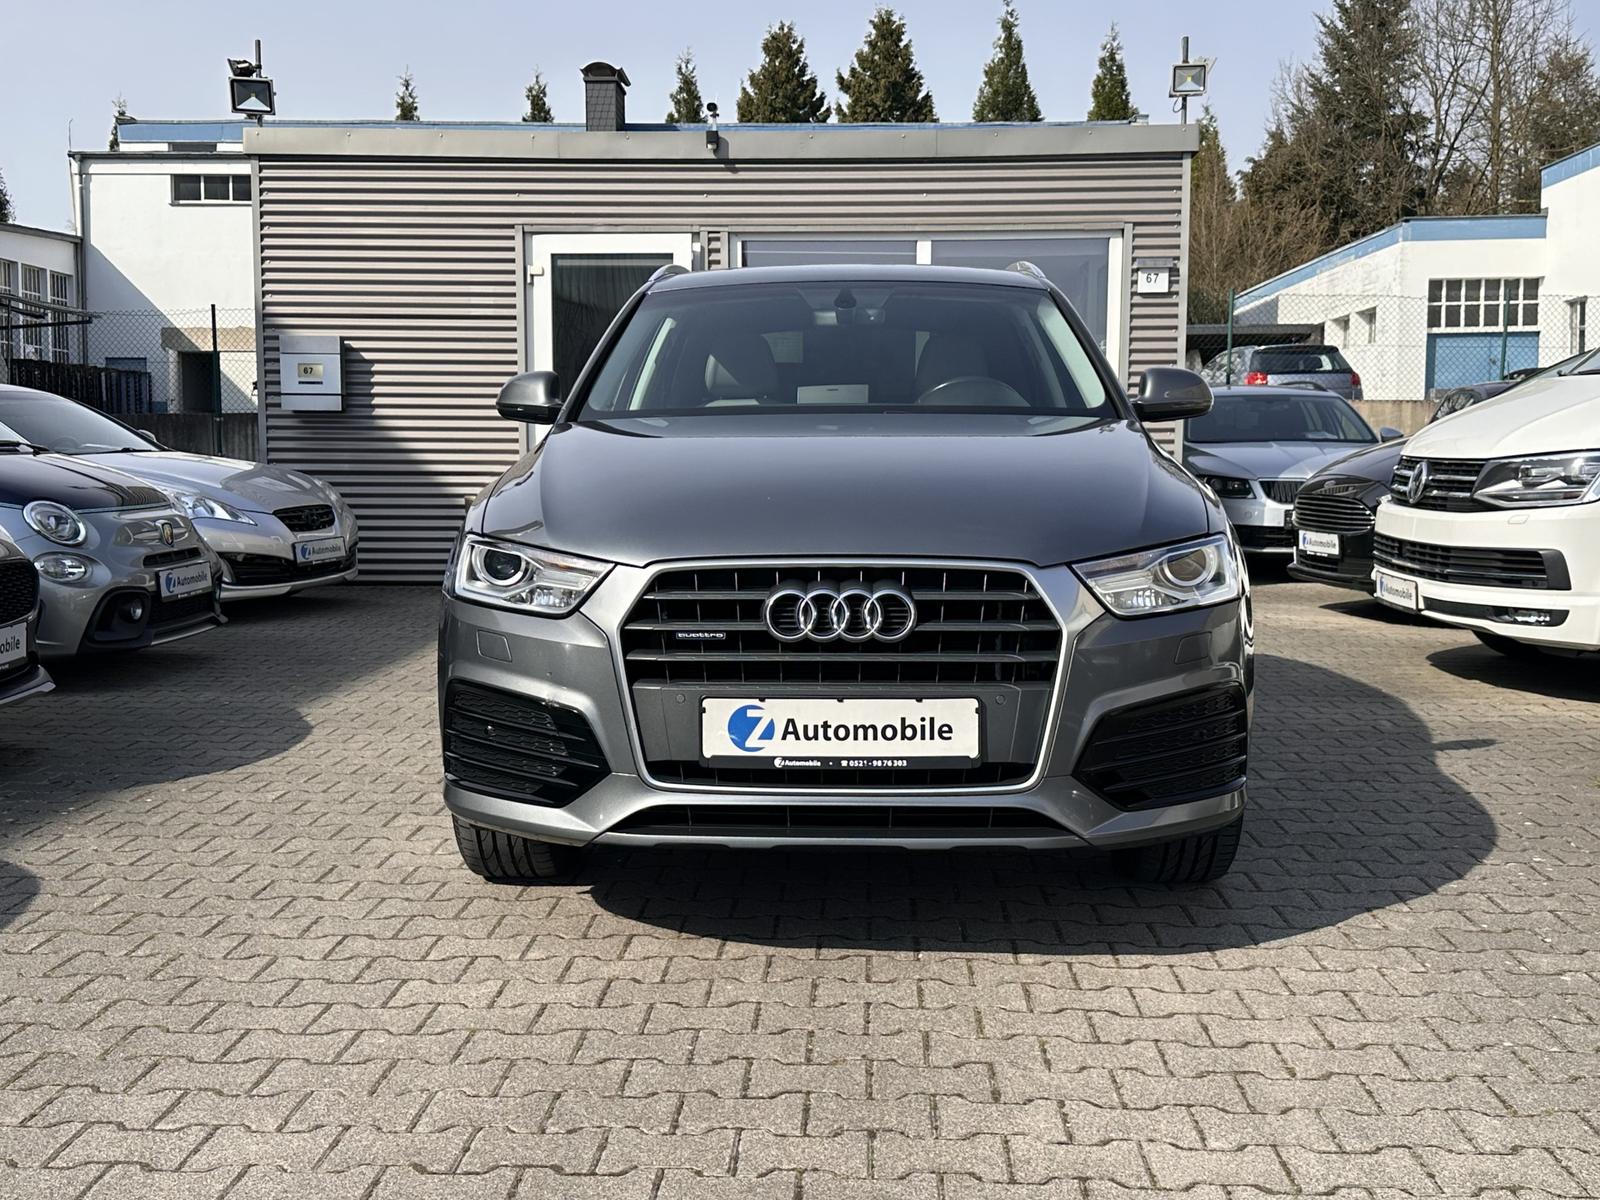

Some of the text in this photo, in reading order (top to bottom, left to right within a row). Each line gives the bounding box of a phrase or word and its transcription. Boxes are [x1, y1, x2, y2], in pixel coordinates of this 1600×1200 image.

[1145, 272, 1159, 284] 67
[303, 366, 314, 375] 67
[177, 571, 208, 586] Automobile
[781, 716, 954, 742] Automobile
[785, 759, 821, 767] Automobile
